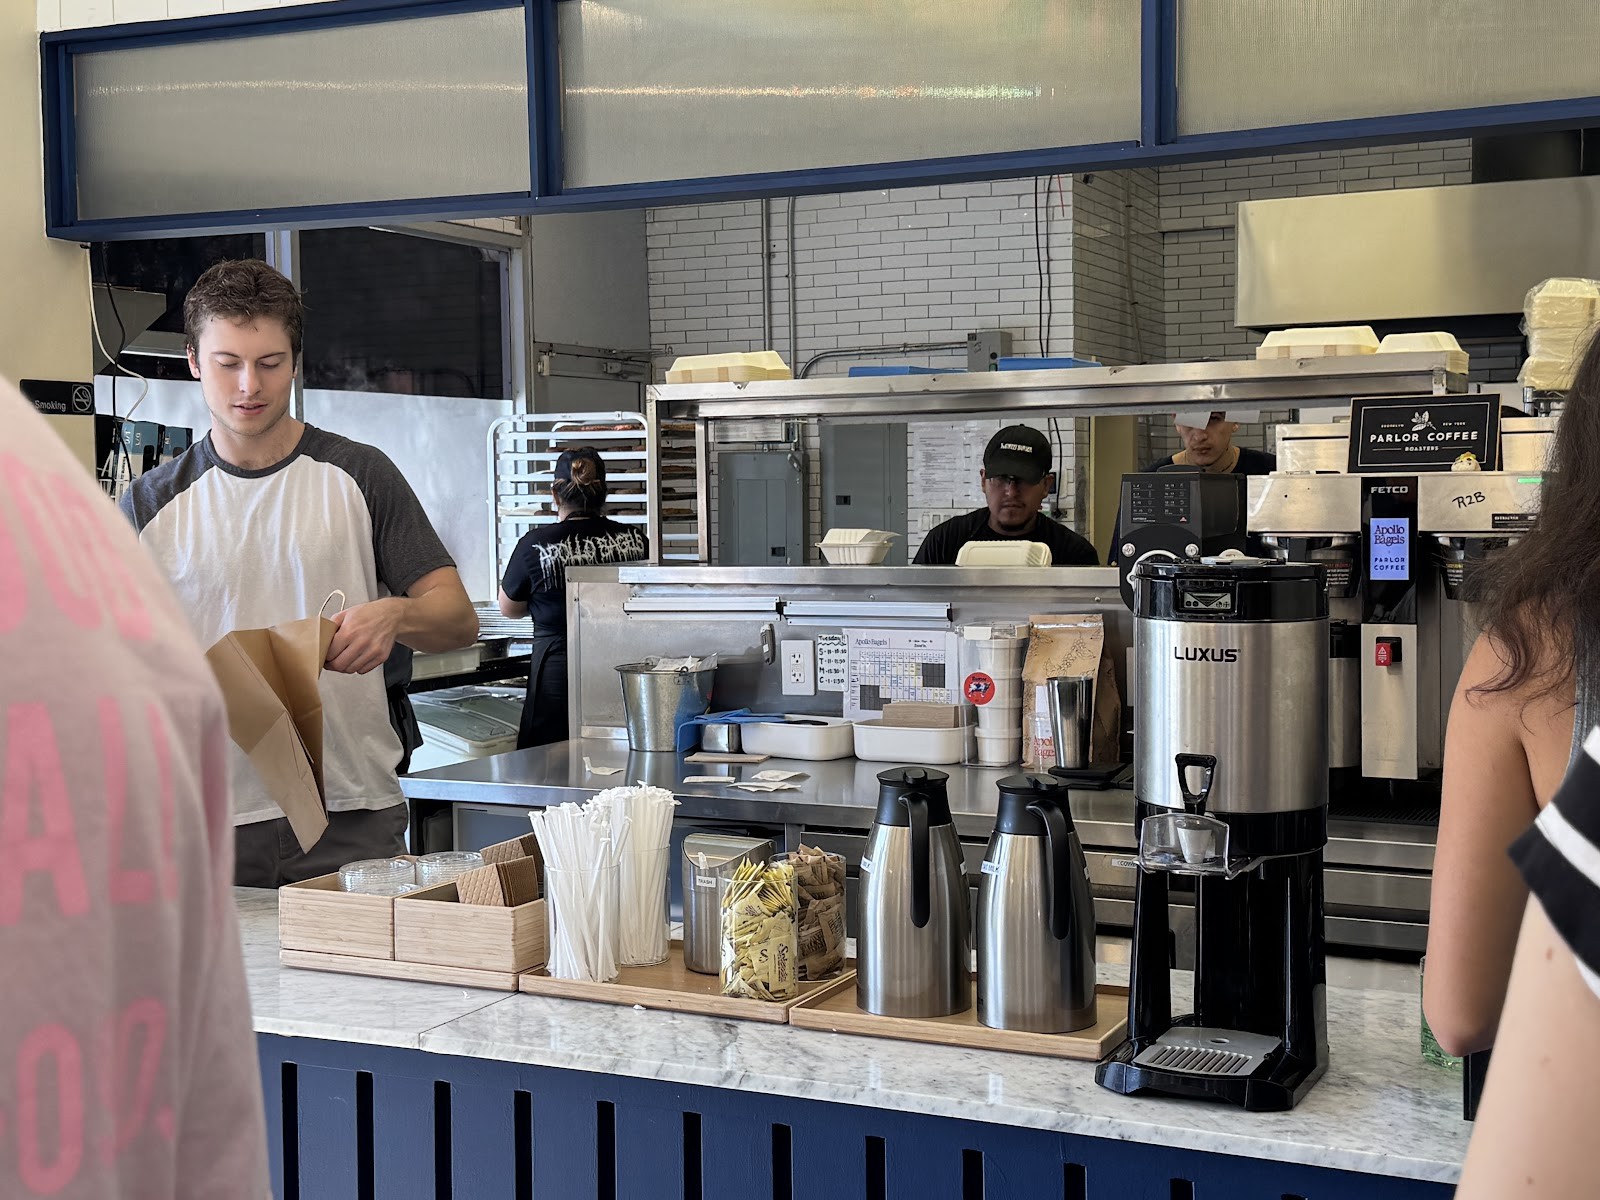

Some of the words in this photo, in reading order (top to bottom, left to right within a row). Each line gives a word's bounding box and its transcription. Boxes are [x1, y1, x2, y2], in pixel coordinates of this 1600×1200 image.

[34, 400, 66, 412] Smoking
[1369, 433, 1420, 443] PARLOR
[1427, 431, 1478, 441] COFFEE
[1370, 486, 1409, 494] FETCO
[1452, 491, 1486, 508] R2B
[1374, 525, 1405, 534] Apollo
[1374, 534, 1405, 547] Bagels
[855, 638, 870, 646] Apollo
[1174, 647, 1238, 662] LUXUS
[1034, 736, 1054, 747] Apol
[1034, 746, 1055, 759] Bage
